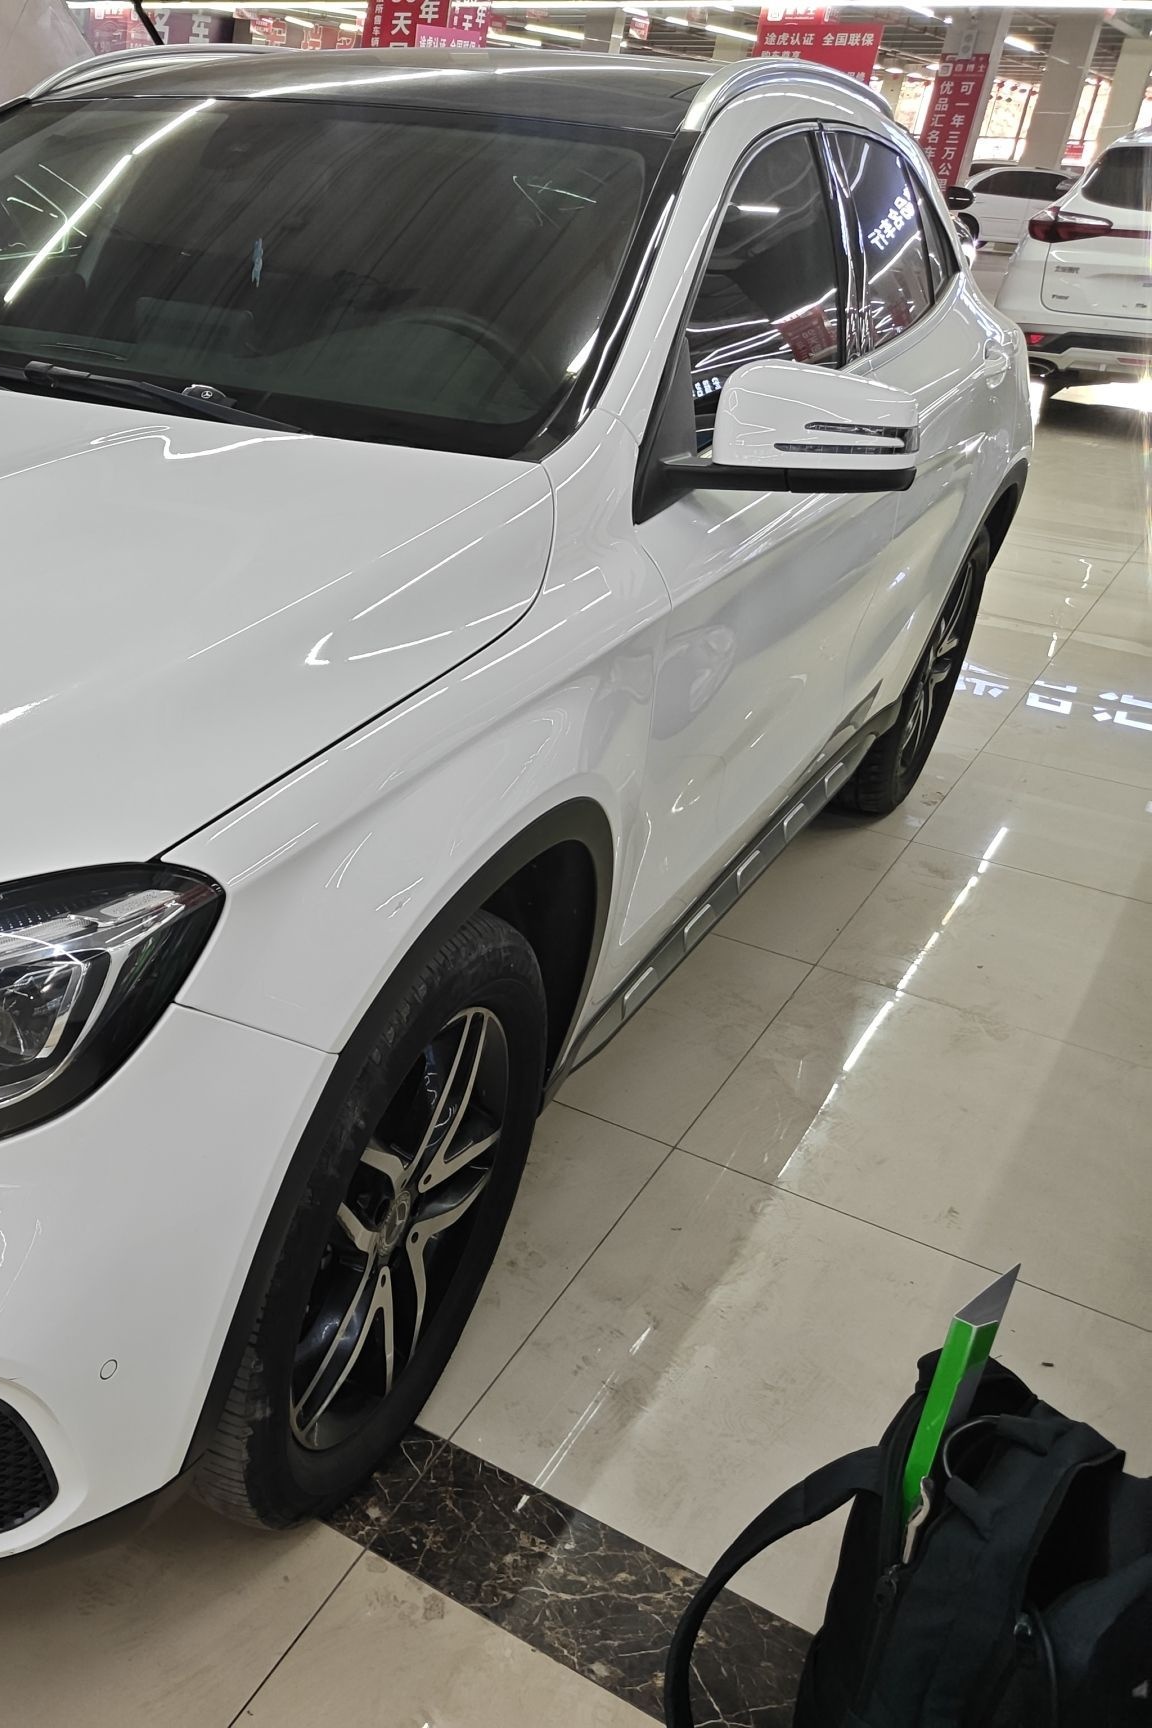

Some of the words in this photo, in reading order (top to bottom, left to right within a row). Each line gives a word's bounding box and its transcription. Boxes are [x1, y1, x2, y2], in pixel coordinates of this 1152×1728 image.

[764, 33, 815, 46] 途虎认证
[822, 33, 874, 46] 全国联保
